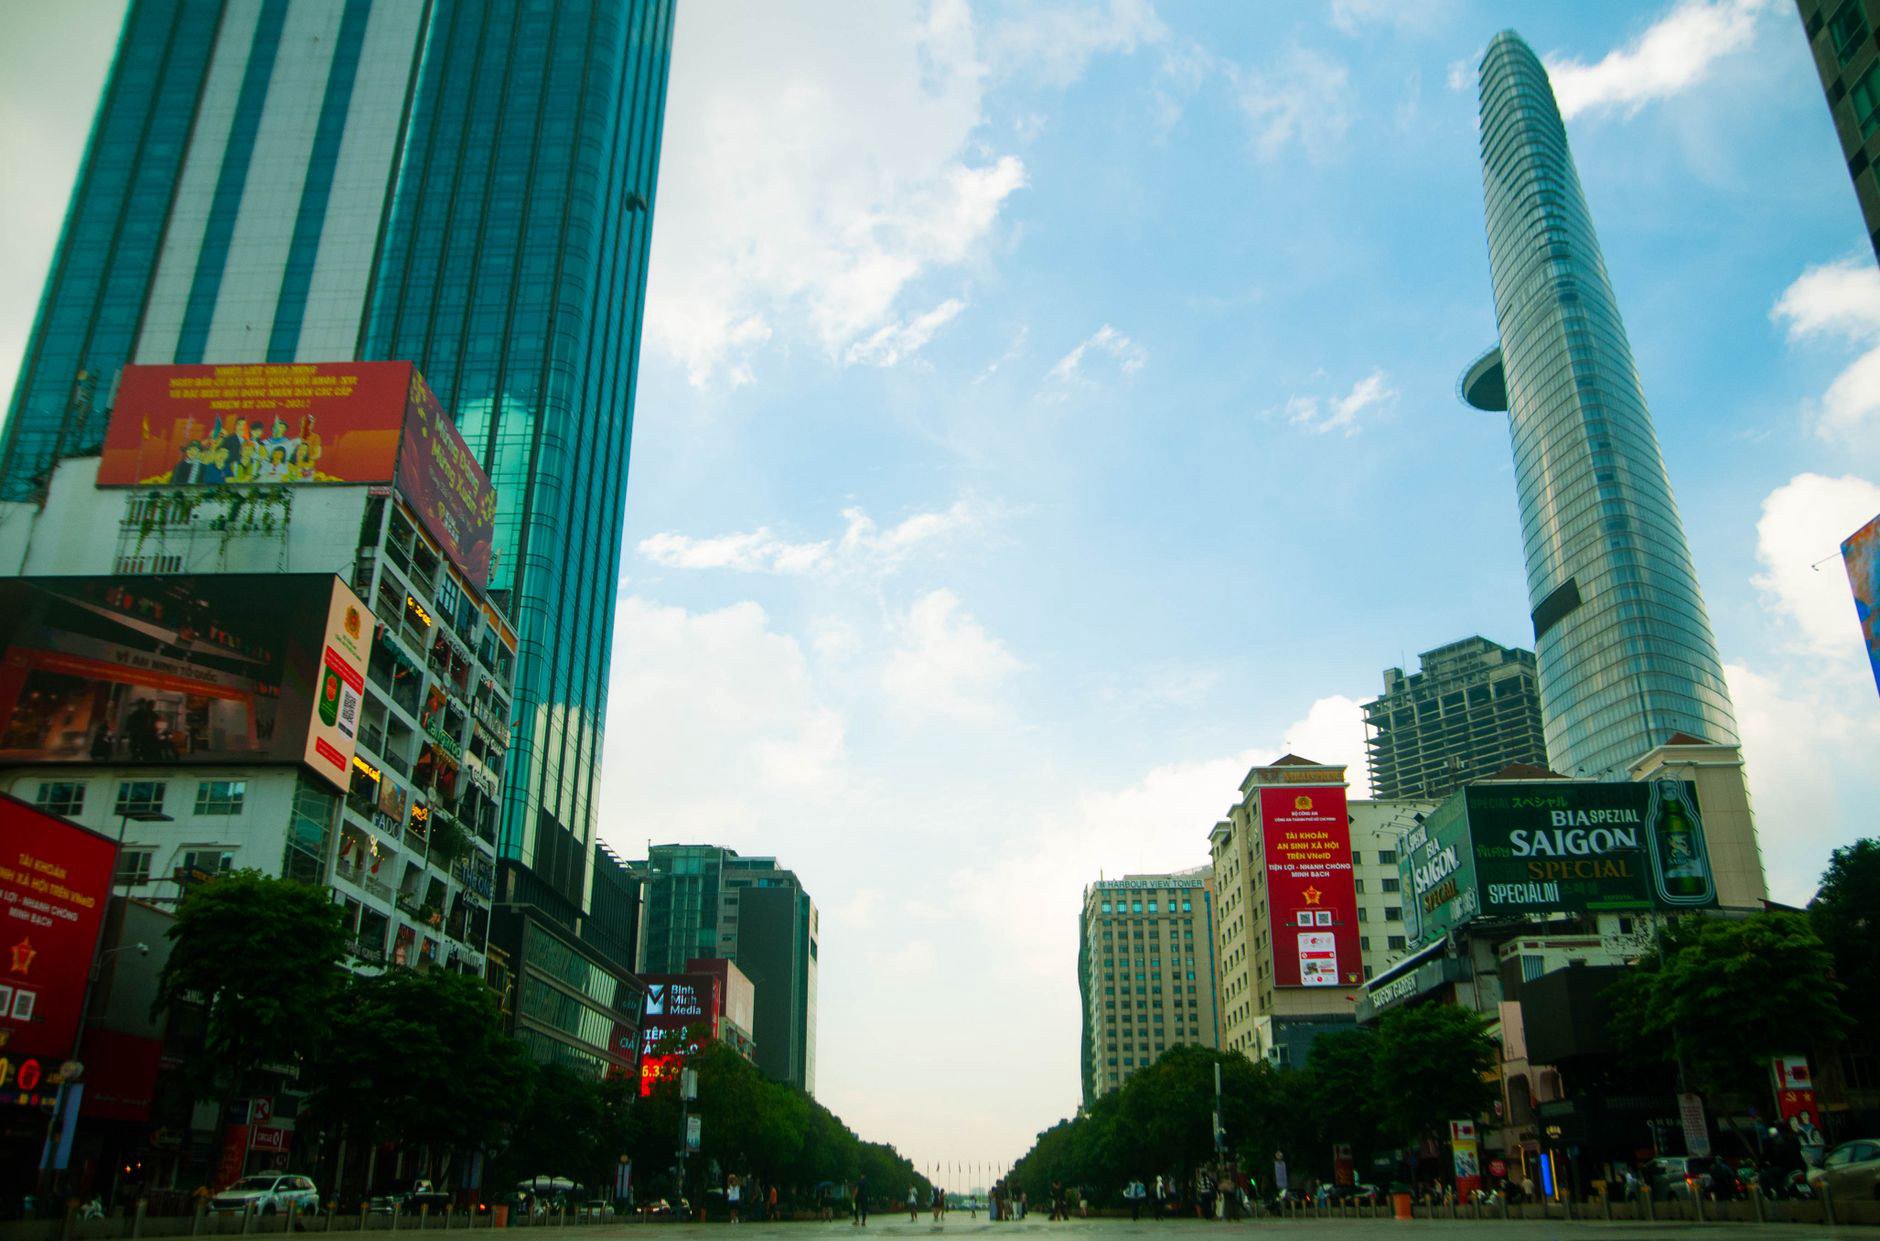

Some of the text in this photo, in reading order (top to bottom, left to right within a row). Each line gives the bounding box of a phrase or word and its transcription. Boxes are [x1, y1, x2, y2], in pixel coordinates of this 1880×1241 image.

[1551, 809, 1640, 827] BIA SPEZIAL
[1291, 842, 1309, 850] SINH
[1426, 838, 1441, 859] BIA
[1509, 828, 1639, 857] SAIGON
[1527, 859, 1634, 880] SPECIAL
[1108, 879, 1202, 888] HARBOUR VIEW TOWER
[1488, 880, 1560, 904] SPECIÁLNÍ
[670, 1005, 702, 1015] Media
